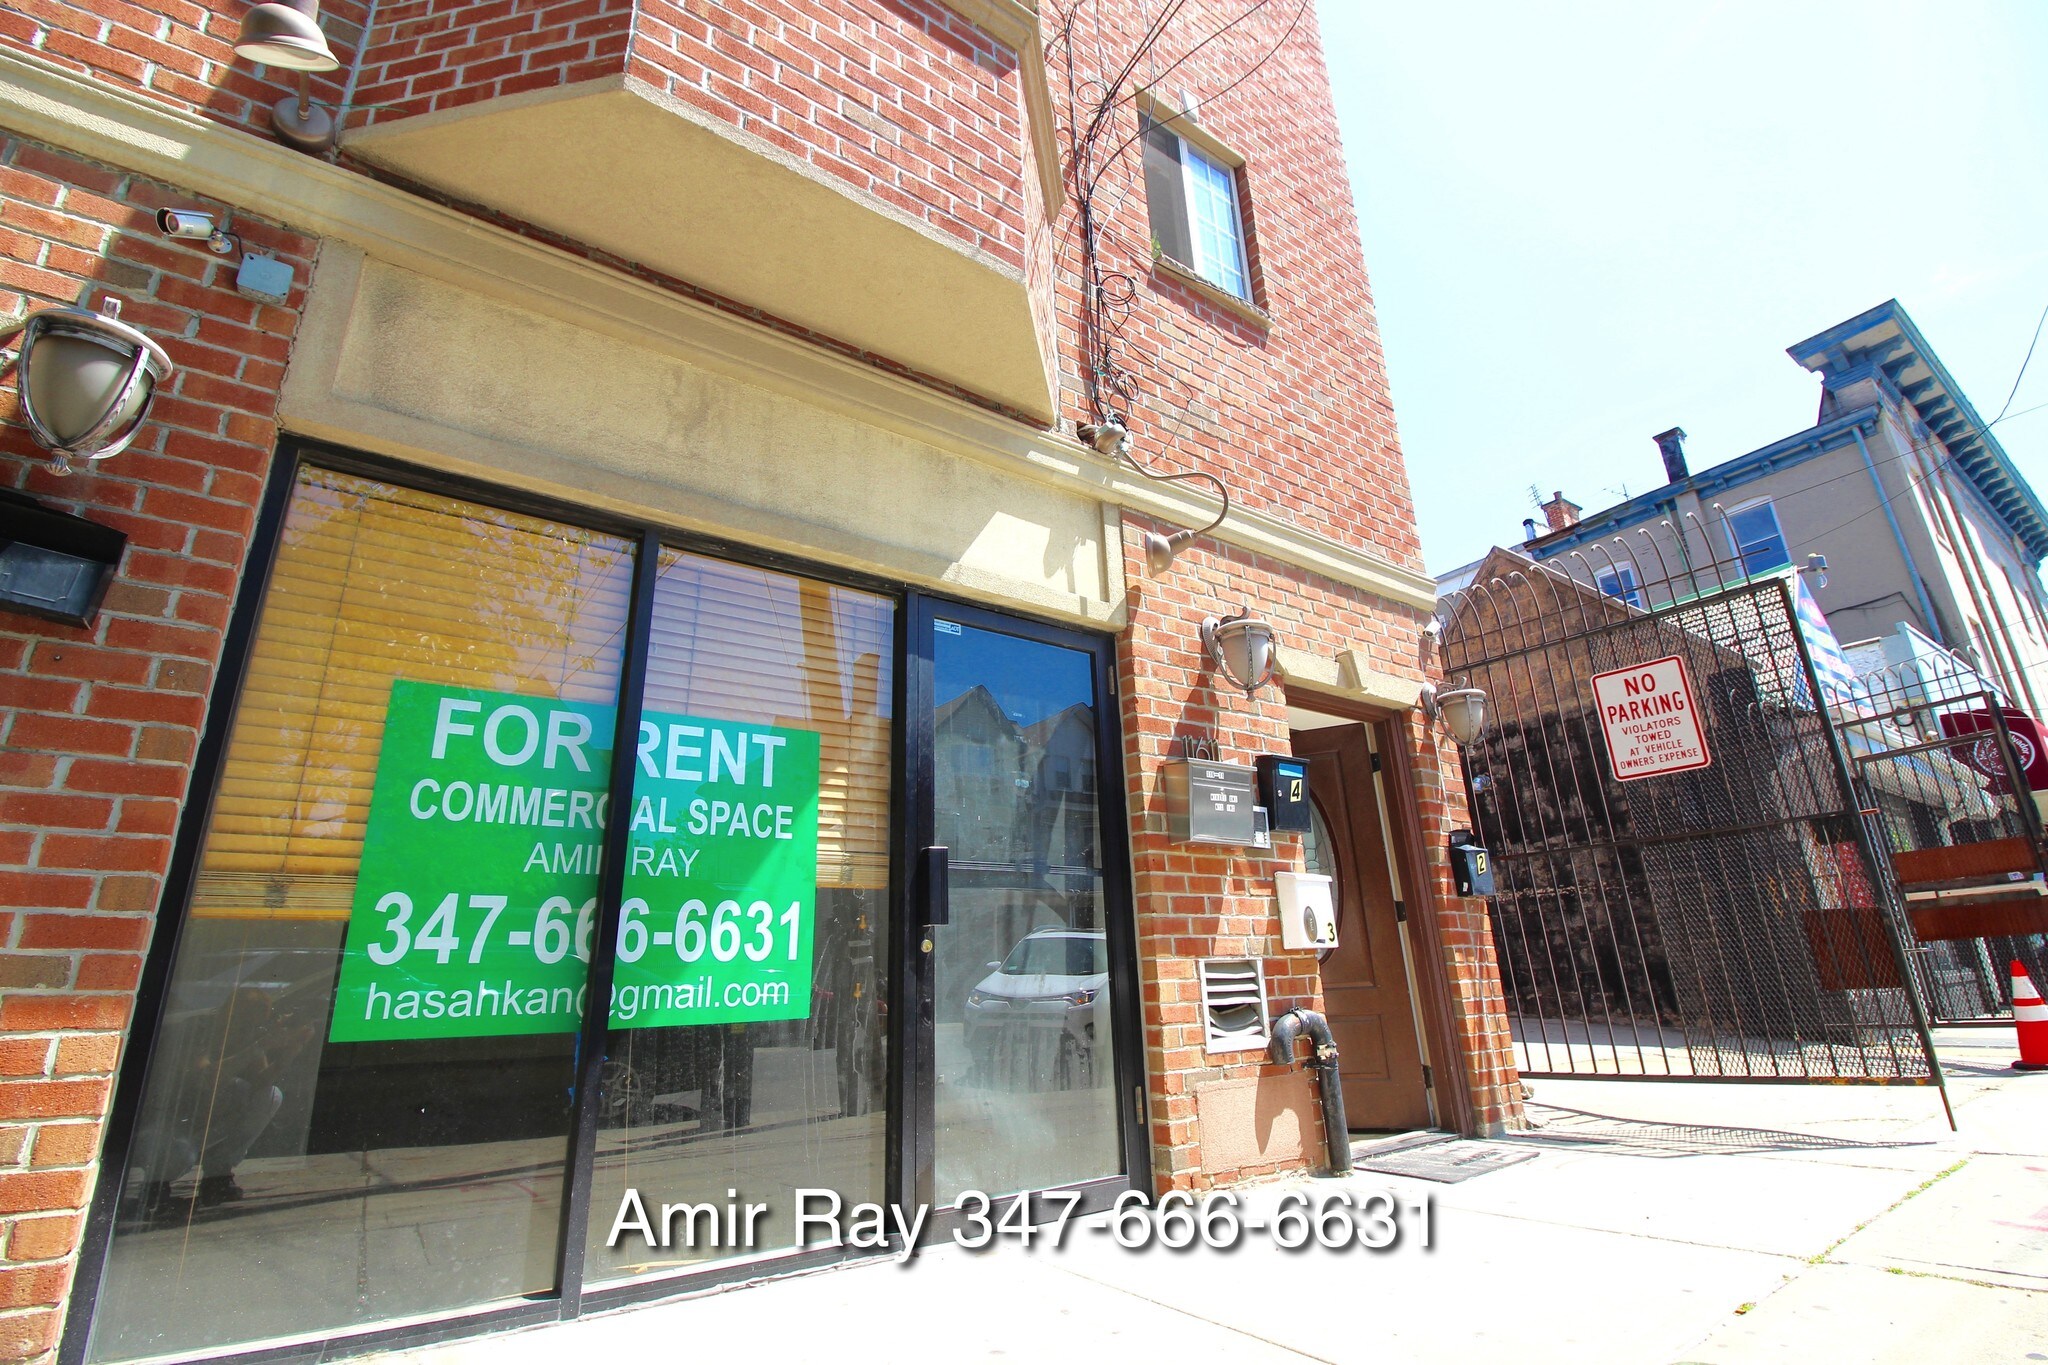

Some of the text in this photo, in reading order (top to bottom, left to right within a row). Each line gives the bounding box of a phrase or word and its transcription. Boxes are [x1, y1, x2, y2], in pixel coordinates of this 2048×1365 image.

[1624, 674, 1655, 696] NO
[1607, 692, 1684, 724] PARKING
[1621, 716, 1681, 736] VIOLATORS
[430, 697, 787, 787] FOR RENT
[1635, 729, 1672, 744] TOWED
[1629, 739, 1683, 757] AT VEHICLE
[1621, 748, 1698, 769] OWNERS EXPENSE
[1291, 781, 1300, 800] 4
[409, 777, 794, 840] COMMERCAL SPACE
[522, 842, 700, 878] AMI RAY
[1478, 855, 1485, 871] 2
[1327, 922, 1336, 942] 3
